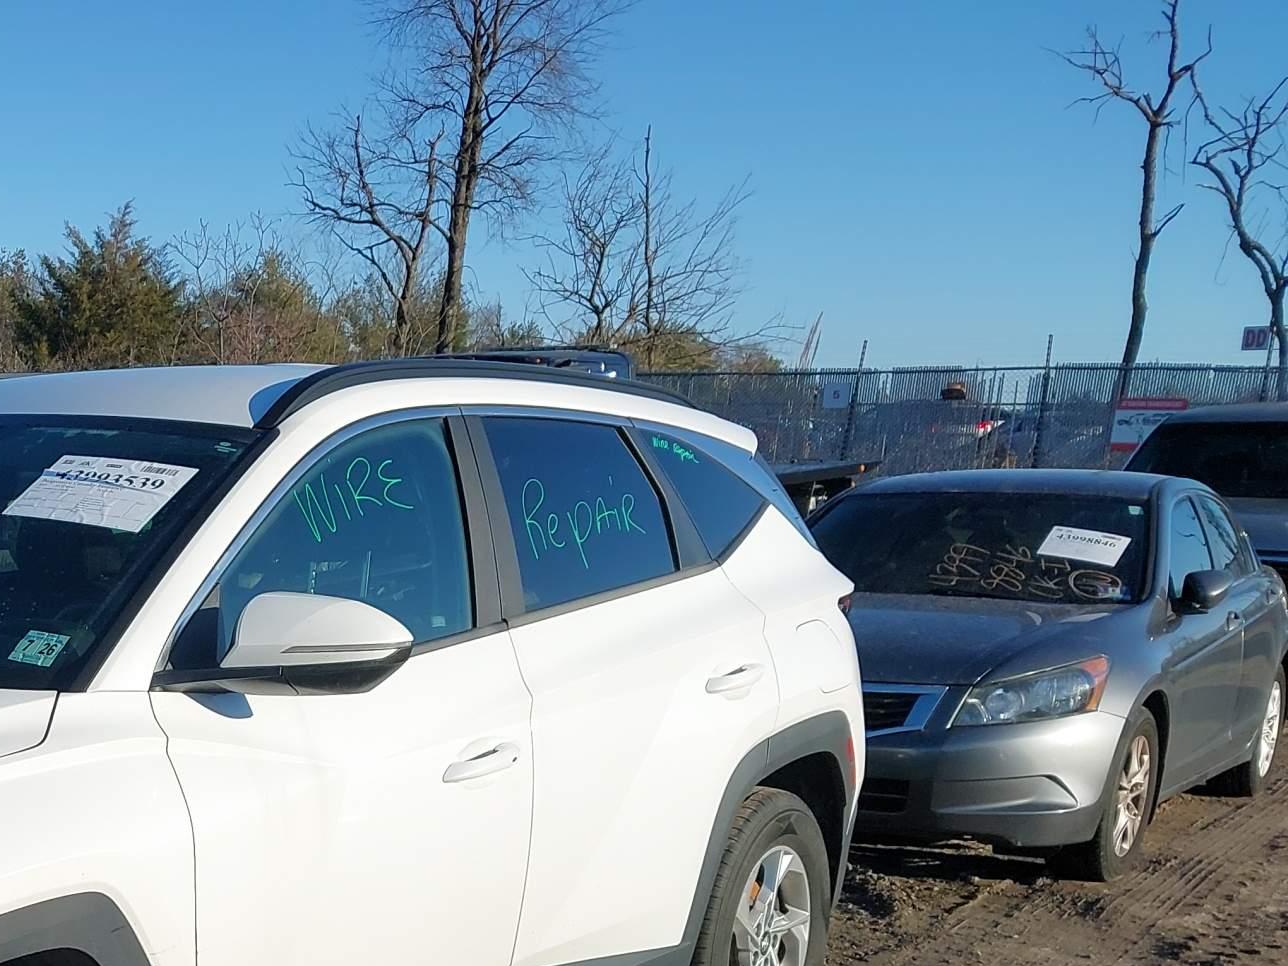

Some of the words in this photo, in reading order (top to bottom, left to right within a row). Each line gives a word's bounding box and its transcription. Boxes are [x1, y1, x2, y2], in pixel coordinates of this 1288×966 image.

[292, 457, 415, 543] WIRE
[22, 639, 37, 651] 7
[37, 642, 58, 656] 26
